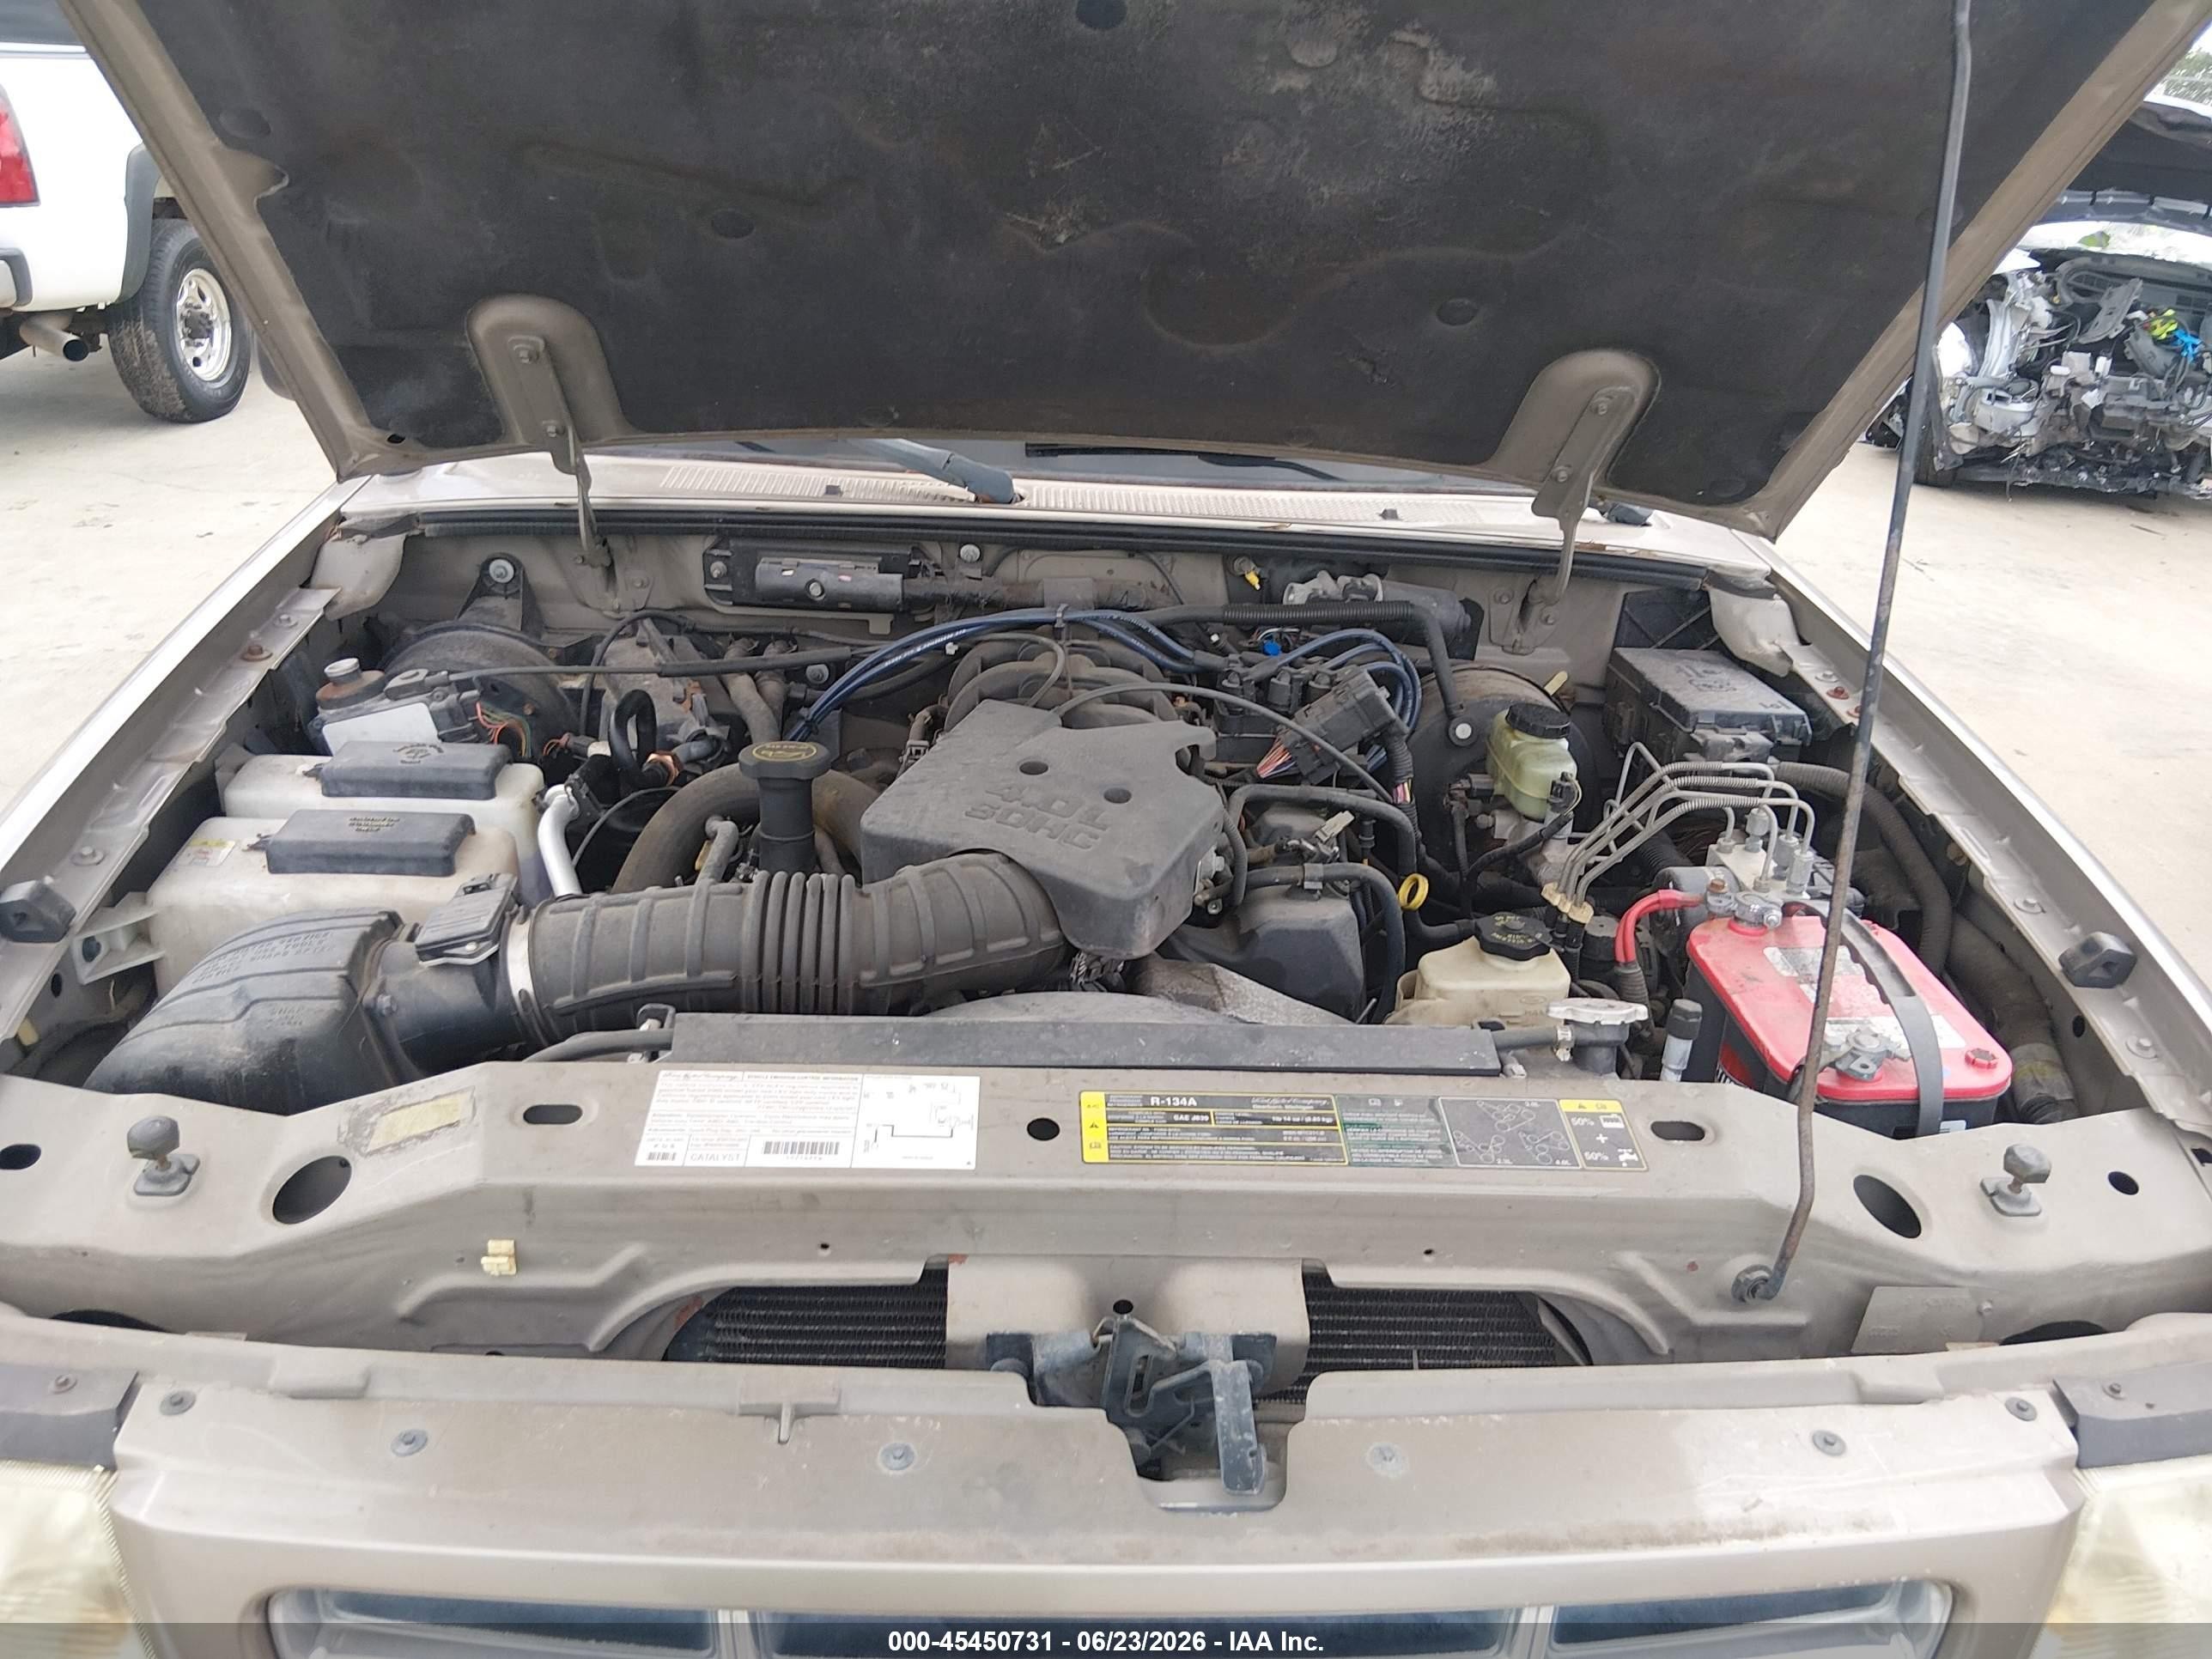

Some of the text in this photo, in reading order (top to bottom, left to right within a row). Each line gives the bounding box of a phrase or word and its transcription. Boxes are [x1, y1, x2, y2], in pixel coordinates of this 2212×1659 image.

[1151, 1097, 1197, 1107] R-134A
[1571, 1116, 1595, 1126] 50%
[690, 1152, 741, 1162] CATALYST
[1584, 1152, 1608, 1161] 50%
